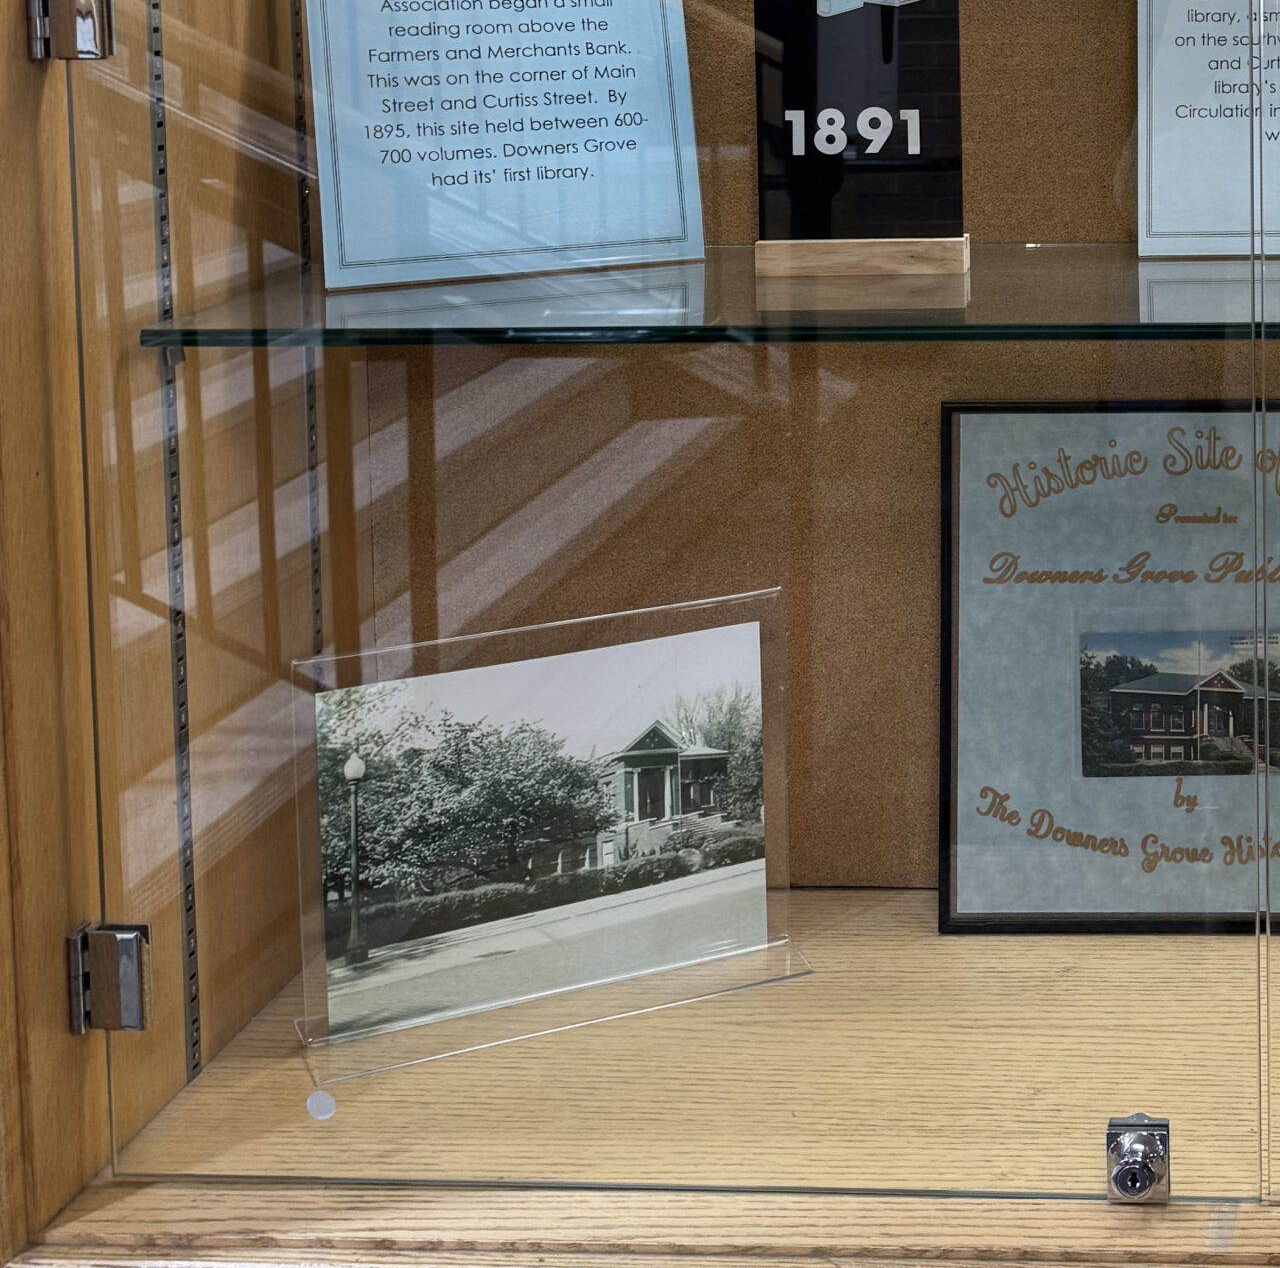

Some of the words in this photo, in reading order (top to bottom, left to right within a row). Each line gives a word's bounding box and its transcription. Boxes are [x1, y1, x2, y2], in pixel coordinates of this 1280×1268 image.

[389, 21, 460, 39] reading
[466, 23, 512, 35] room
[518, 20, 575, 33] above
[580, 17, 608, 31] the
[1187, 9, 1241, 25] library,
[369, 49, 440, 63] Farmers
[445, 45, 481, 60] and
[488, 42, 580, 59] Merchants
[586, 41, 631, 55] Bank.
[1208, 56, 1241, 70] and
[1214, 80, 1277, 96] libray's
[382, 97, 435, 113] Street
[441, 95, 477, 110] and
[483, 92, 540, 110] Curtiss
[543, 90, 598, 107] Street.
[608, 89, 628, 107] By
[1175, 104, 1261, 118] Circulation
[364, 124, 410, 139] 1895,
[416, 122, 445, 137] this
[450, 121, 479, 135] site
[485, 117, 524, 134] held
[530, 116, 608, 131] between
[614, 112, 648, 127] 600-
[785, 108, 922, 156] 1891
[380, 148, 412, 164] 700
[417, 146, 497, 162] volumes.
[503, 143, 578, 157] Downers
[584, 139, 637, 152] Grove
[432, 170, 468, 186] had
[473, 169, 495, 184] its'
[504, 167, 531, 182] first
[537, 165, 594, 180] library.
[986, 438, 1149, 518] Historic
[1163, 426, 1242, 476] Site
[982, 551, 1108, 584] Downers
[1112, 551, 1198, 583] Grove
[1173, 777, 1198, 813] by
[976, 786, 1022, 826] The
[1026, 809, 1130, 858] Downers
[1140, 833, 1214, 873] Grove
